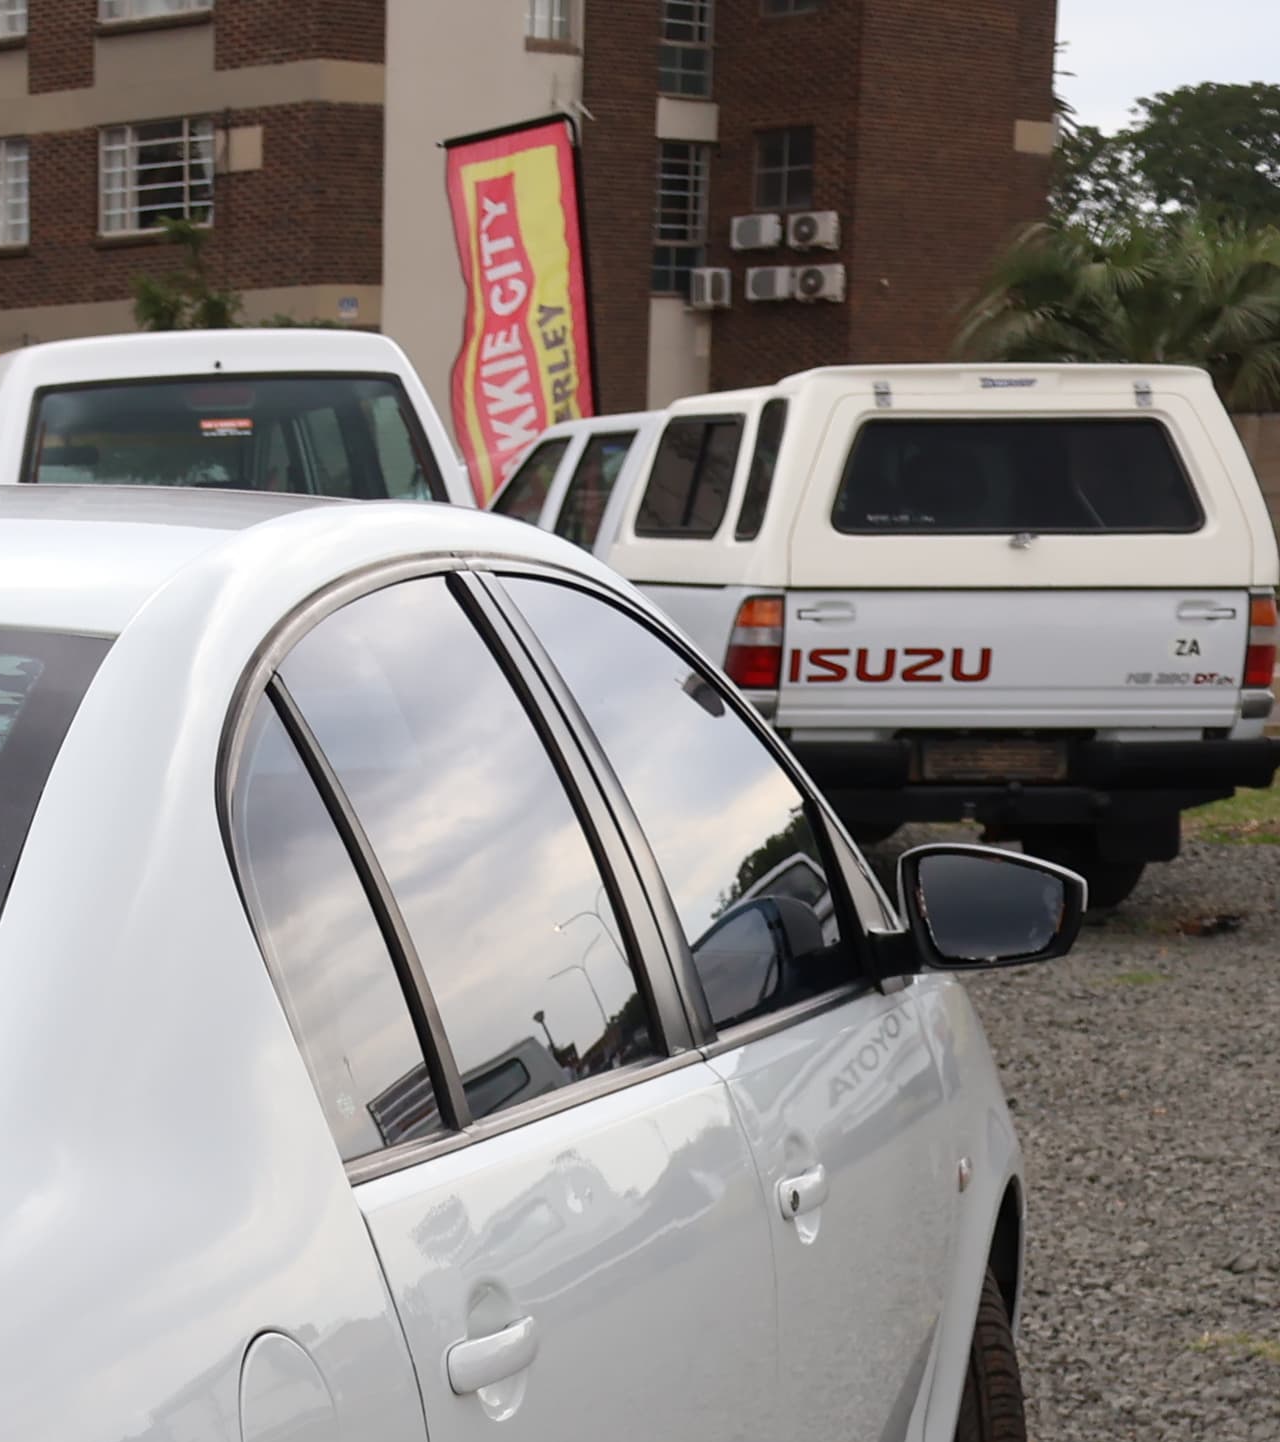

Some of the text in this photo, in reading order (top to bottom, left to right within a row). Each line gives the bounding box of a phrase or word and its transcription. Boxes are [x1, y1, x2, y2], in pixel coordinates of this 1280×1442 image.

[479, 196, 529, 317] CITY
[1175, 639, 1201, 656] ZA
[788, 648, 992, 682] ISUZU
